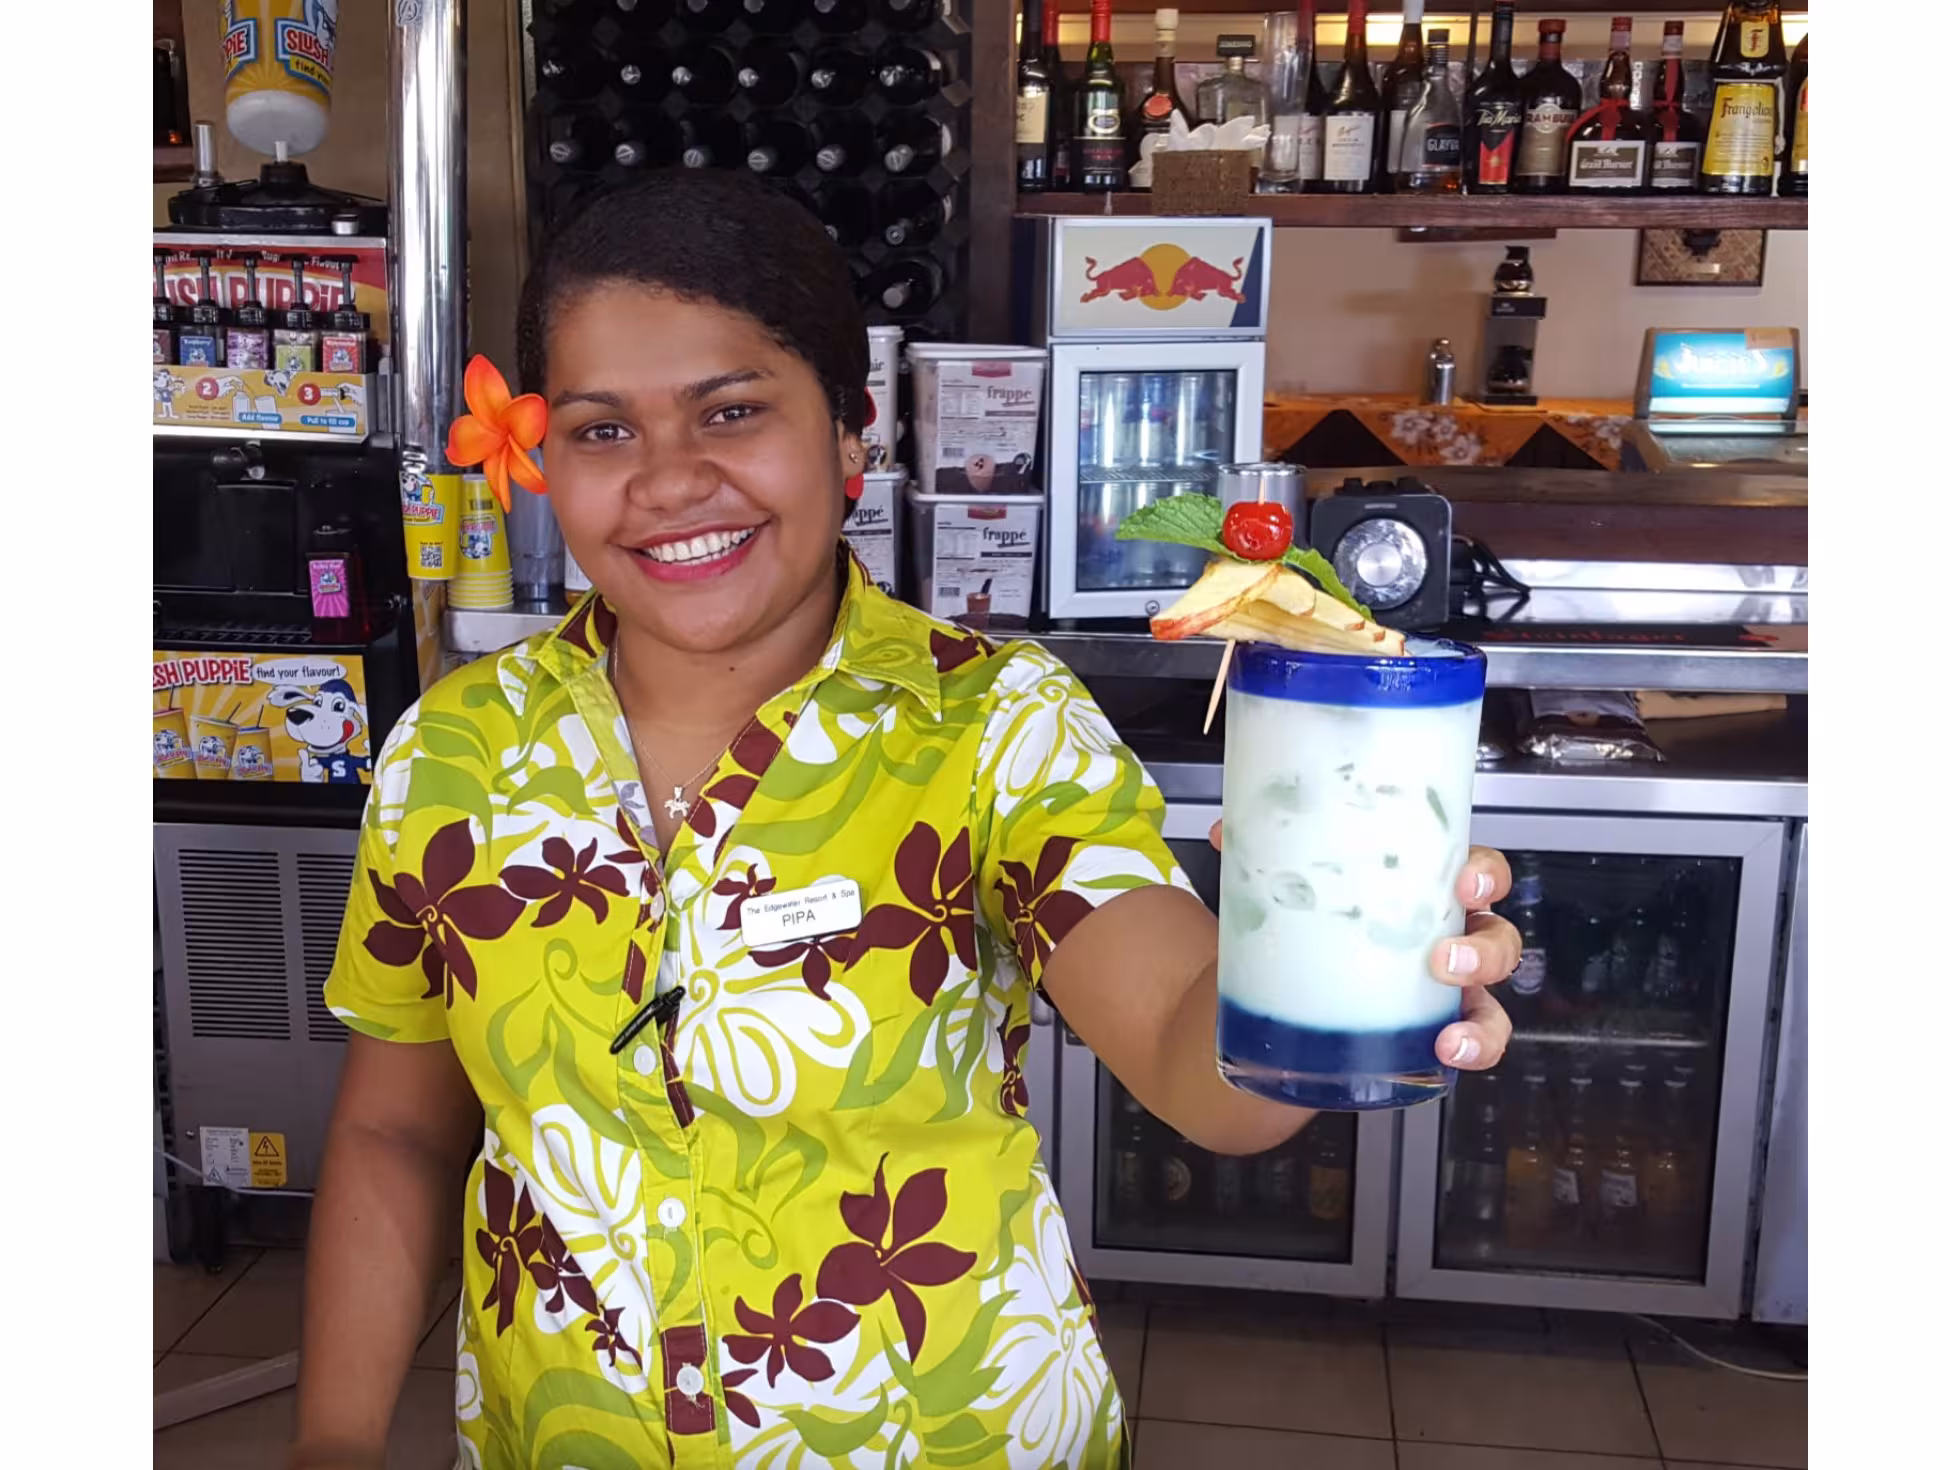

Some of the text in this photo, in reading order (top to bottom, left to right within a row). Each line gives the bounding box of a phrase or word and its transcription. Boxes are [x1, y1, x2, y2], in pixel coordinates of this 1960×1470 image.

[202, 382, 212, 394] 2
[303, 387, 313, 400] 3
[256, 665, 341, 679] find your flavour!
[332, 760, 346, 777] S
[804, 894, 828, 904] Resort
[841, 889, 855, 898] Spa
[782, 909, 816, 927] PIPA
